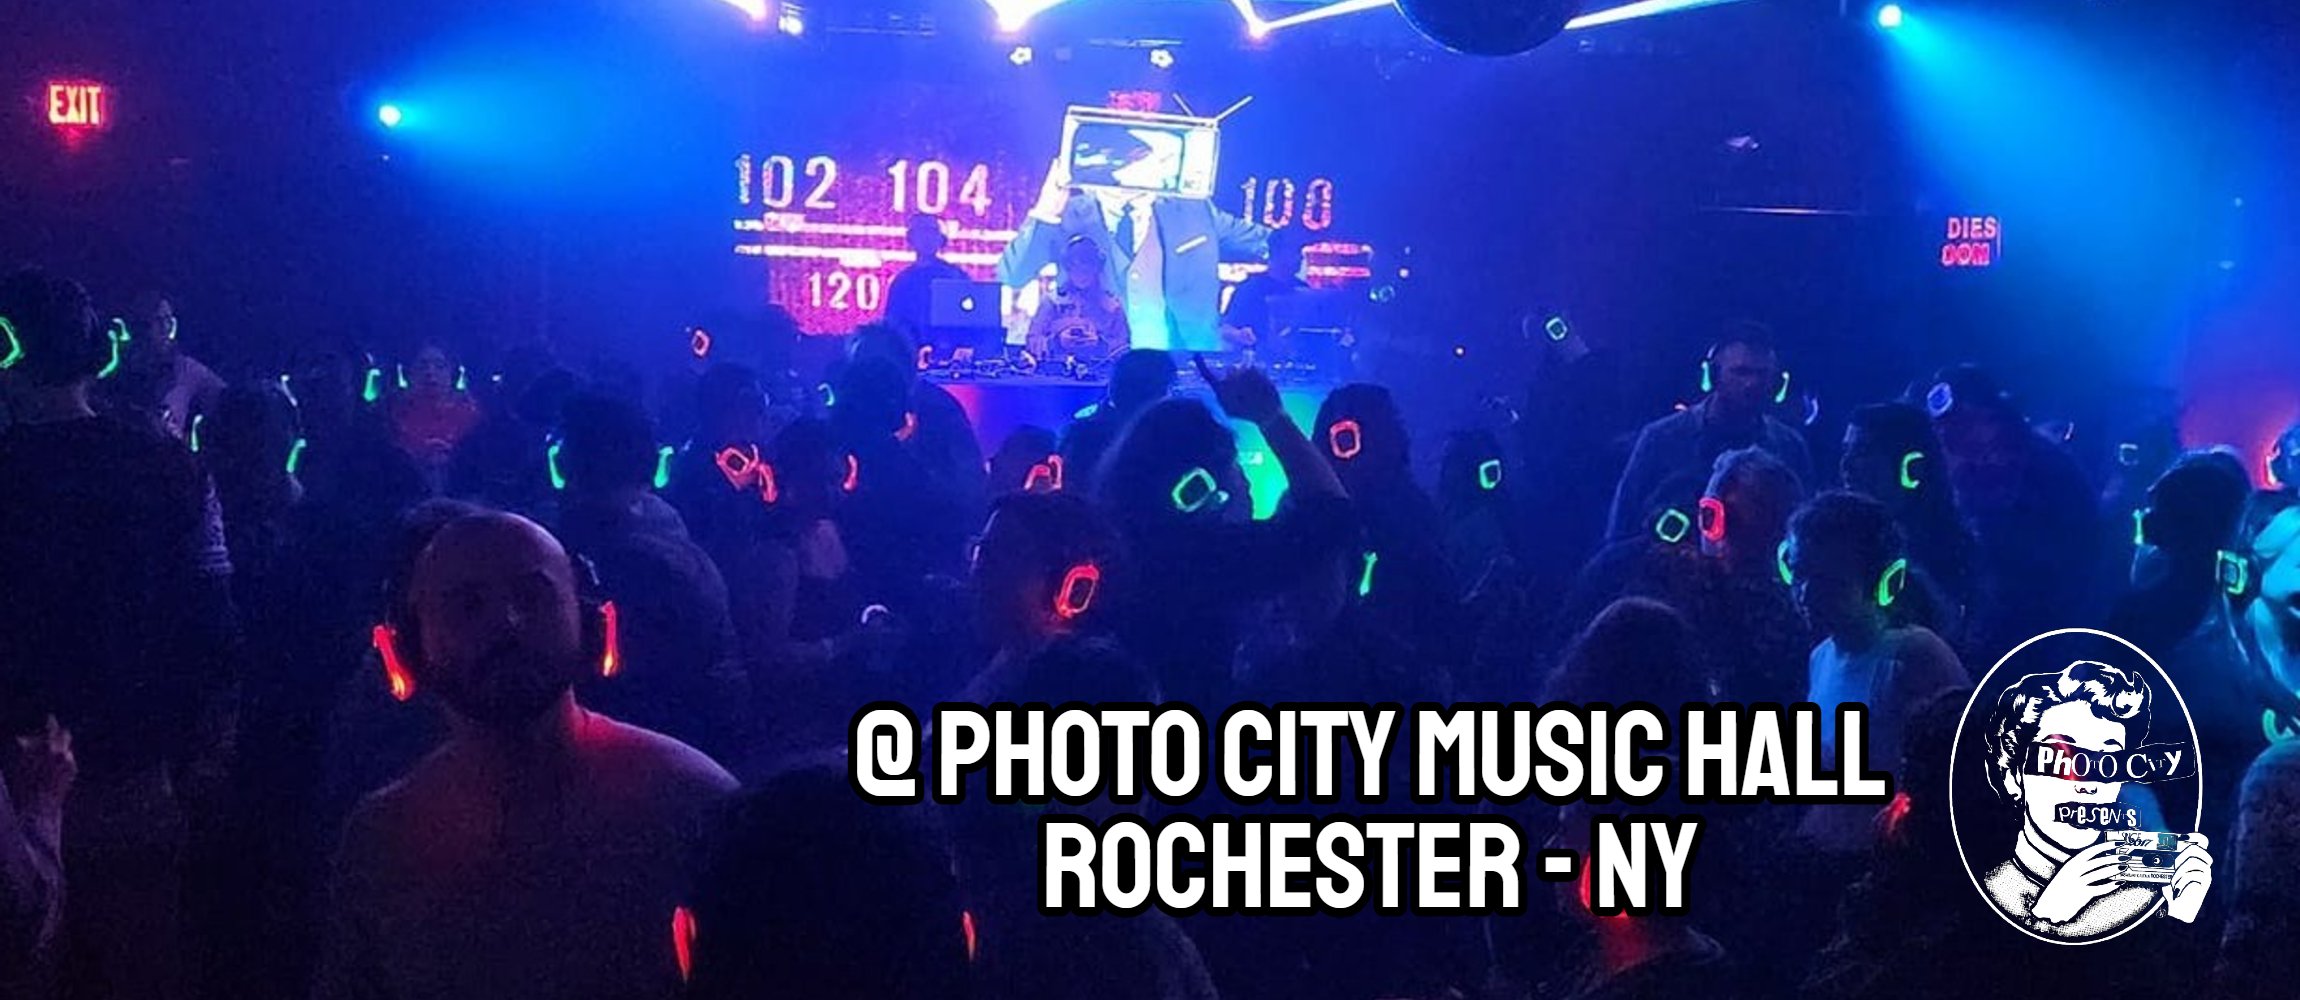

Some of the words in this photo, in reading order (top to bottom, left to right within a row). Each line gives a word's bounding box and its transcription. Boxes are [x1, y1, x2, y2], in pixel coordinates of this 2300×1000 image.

[49, 84, 101, 124] EXIT
[735, 154, 838, 209] 102
[888, 159, 992, 217] 104
[1946, 215, 1997, 240] DIES
[809, 271, 880, 311] 120
